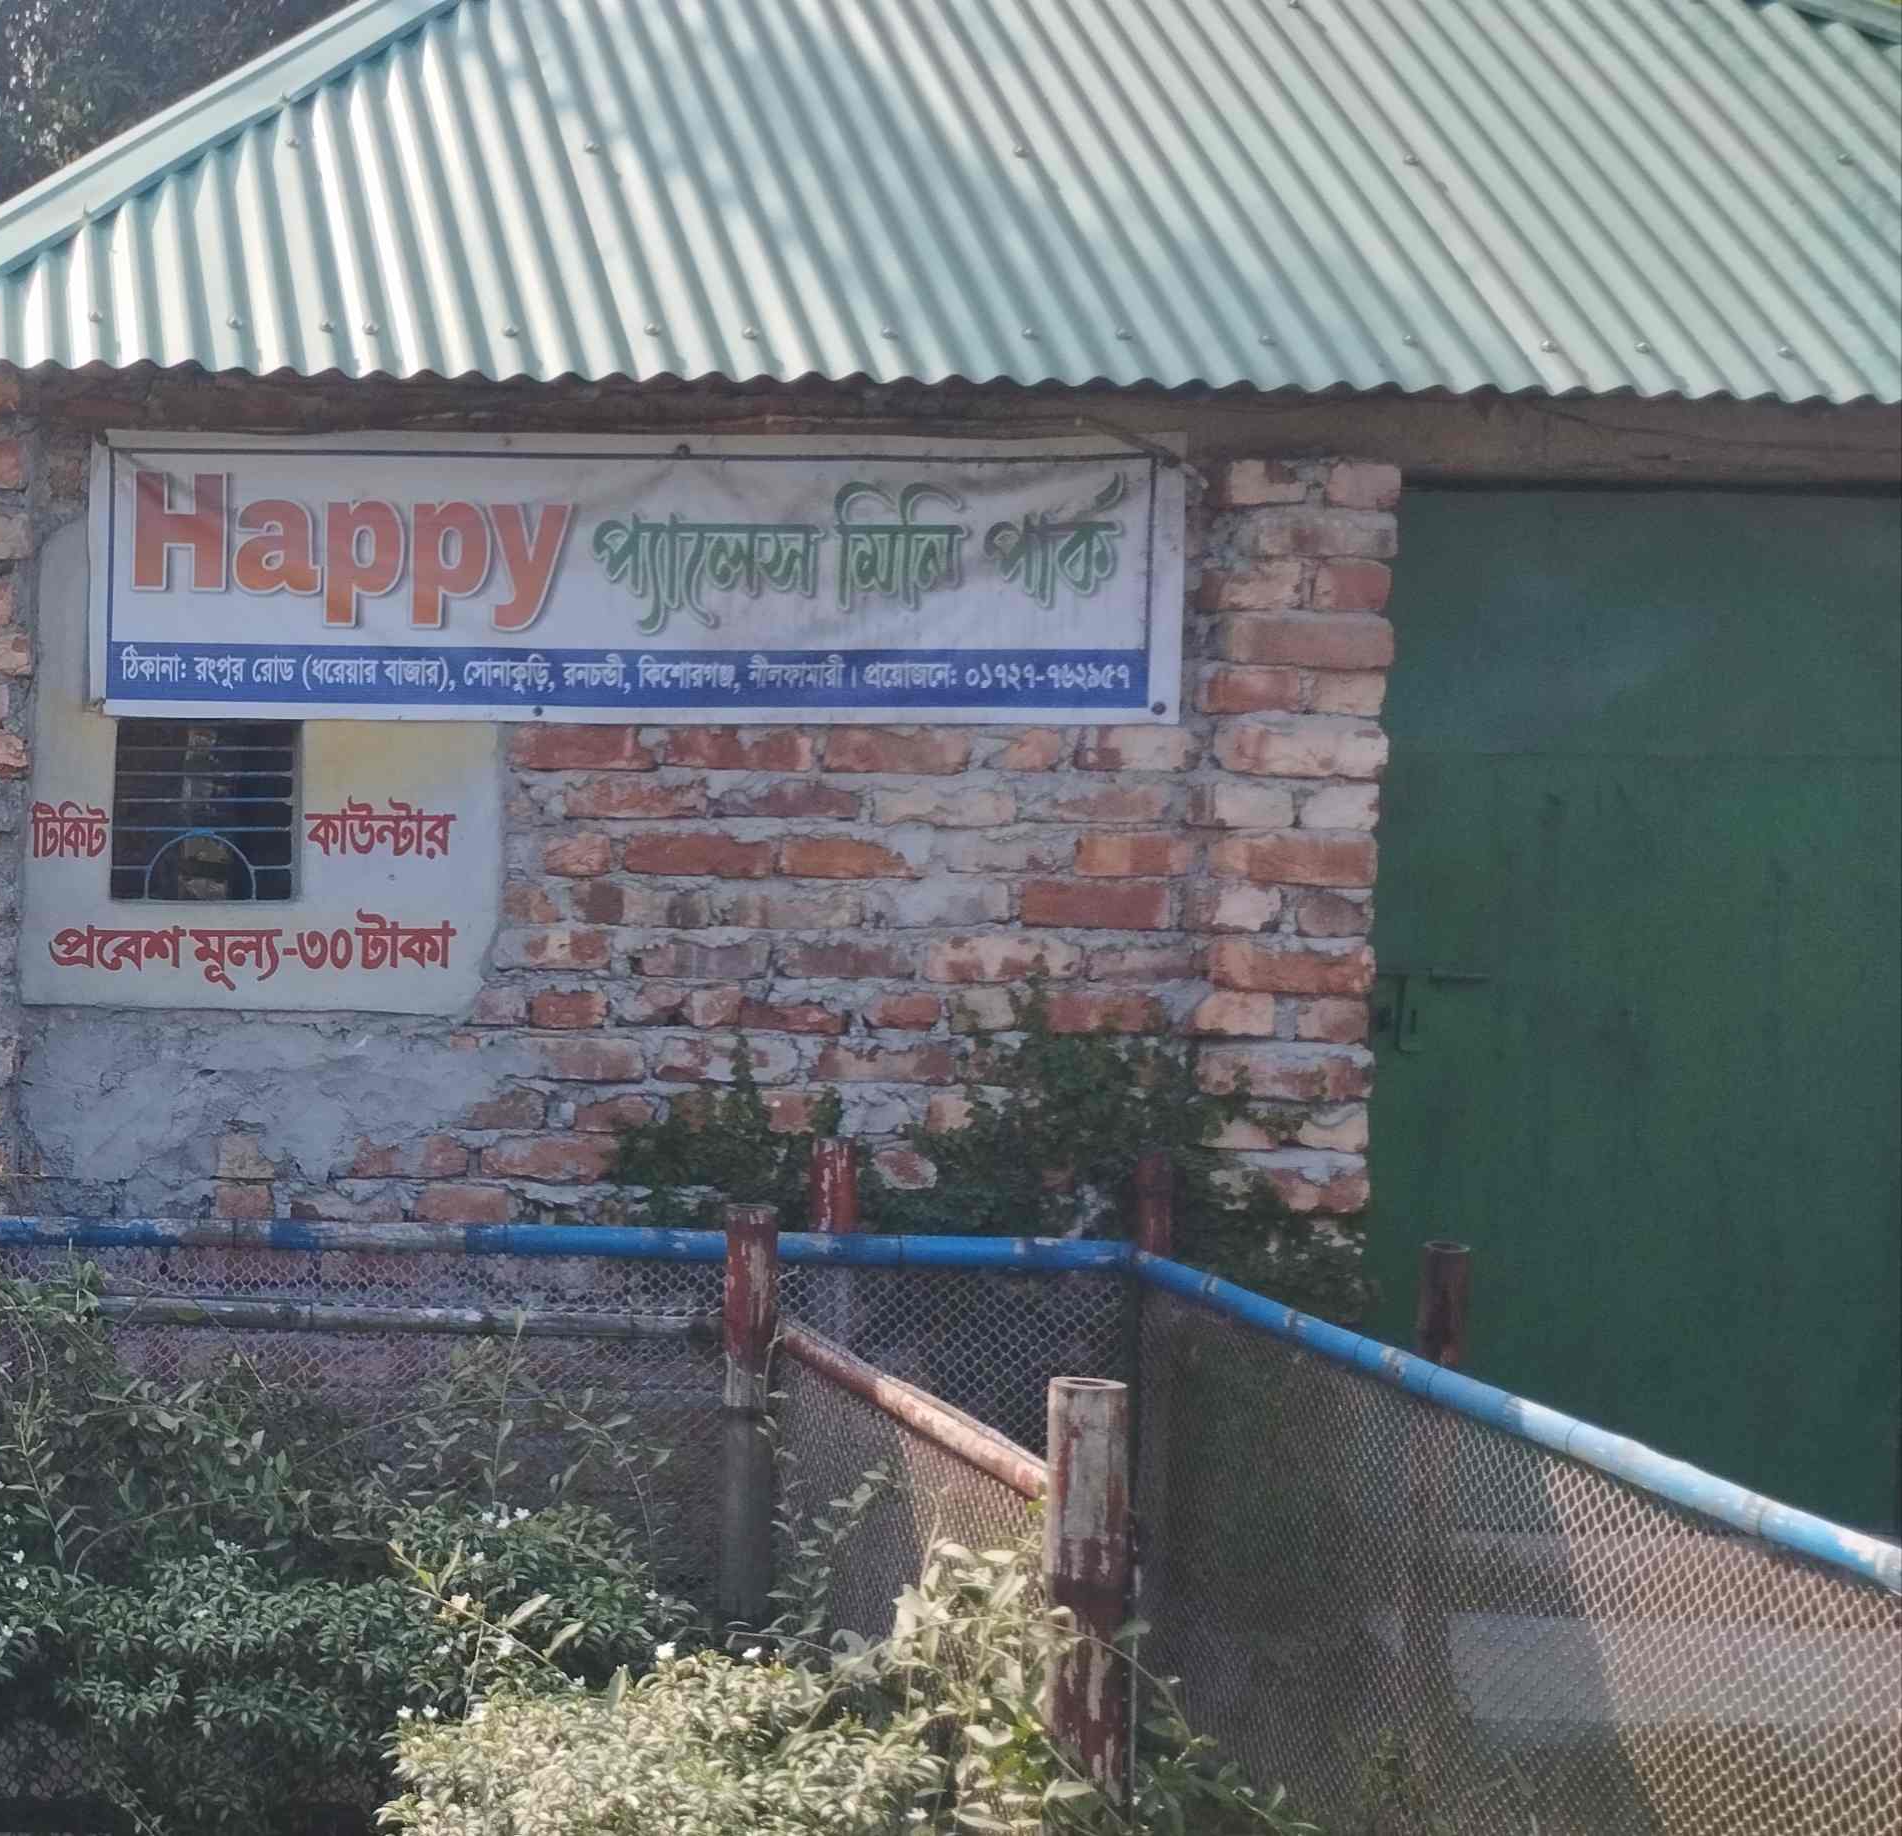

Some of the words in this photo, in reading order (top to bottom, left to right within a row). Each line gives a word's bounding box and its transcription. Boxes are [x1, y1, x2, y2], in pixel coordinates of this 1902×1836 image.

[130, 469, 576, 632] Happy
[594, 505, 825, 634] প্যালেস
[834, 482, 964, 612] মিনি
[983, 470, 1130, 608] পার্ক
[195, 655, 246, 688] রংপুর
[252, 657, 296, 685] রোড
[384, 656, 456, 691] বাজার),
[30, 801, 110, 859] টিকিট
[304, 796, 458, 859] কাউন্টার
[48, 925, 187, 972] প্রবেশ
